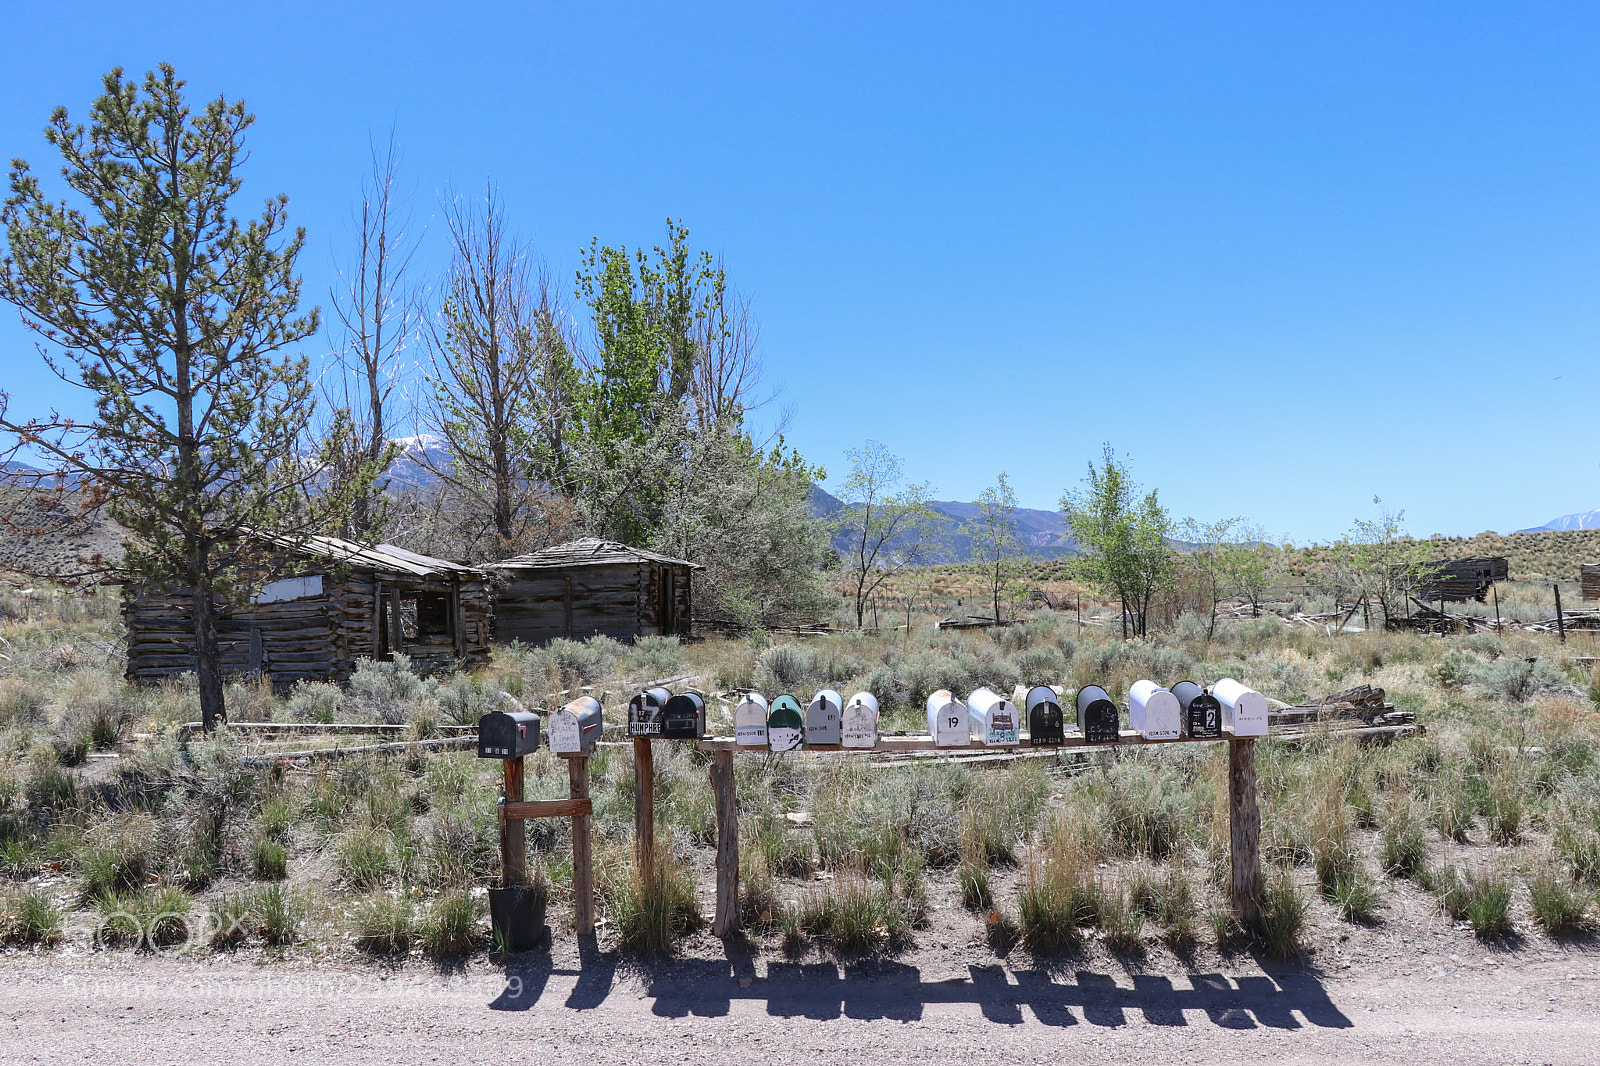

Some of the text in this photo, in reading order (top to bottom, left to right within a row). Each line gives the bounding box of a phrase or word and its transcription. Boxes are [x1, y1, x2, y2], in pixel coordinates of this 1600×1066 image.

[948, 717, 959, 728] 19
[1054, 720, 1060, 728] 6
[1207, 711, 1215, 728] 2
